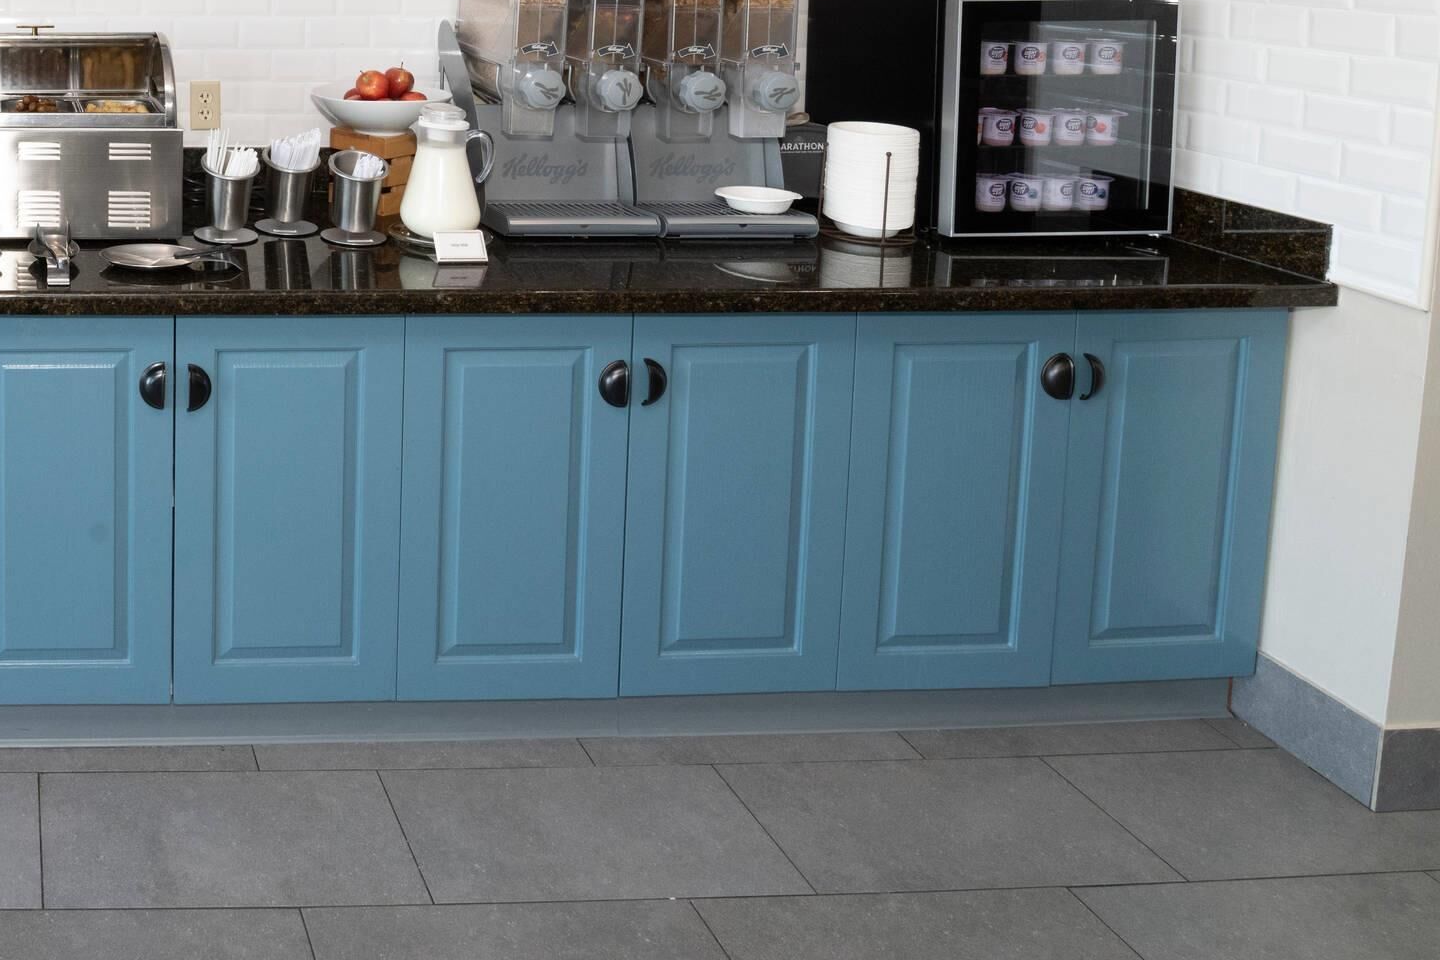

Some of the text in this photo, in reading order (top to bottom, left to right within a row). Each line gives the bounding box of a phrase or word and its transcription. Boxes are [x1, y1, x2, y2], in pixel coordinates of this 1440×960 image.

[780, 142, 824, 151] ARATHON
[502, 152, 589, 185] Kellogg's
[649, 151, 737, 184] Kellogg's
